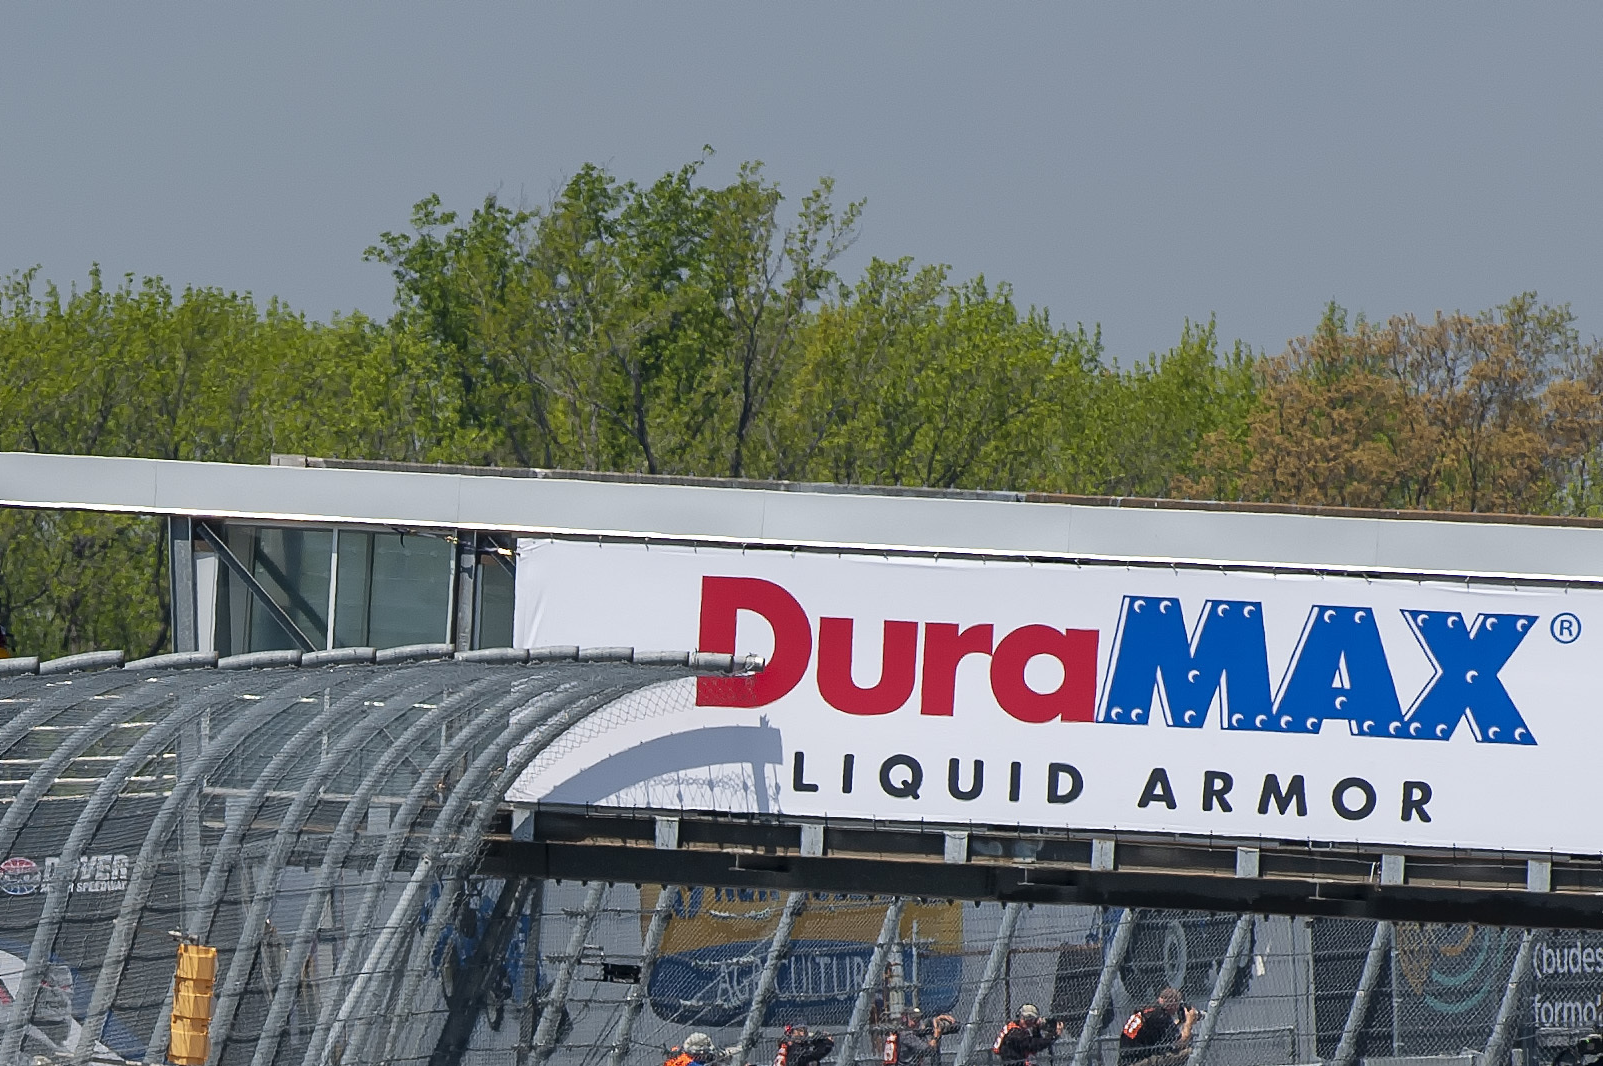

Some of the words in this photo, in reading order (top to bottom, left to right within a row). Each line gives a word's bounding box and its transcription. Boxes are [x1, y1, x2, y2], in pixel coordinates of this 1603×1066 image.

[794, 751, 1085, 804] LIQUID
[1137, 767, 1433, 823] ARMOR
[42, 854, 129, 881] DVER
